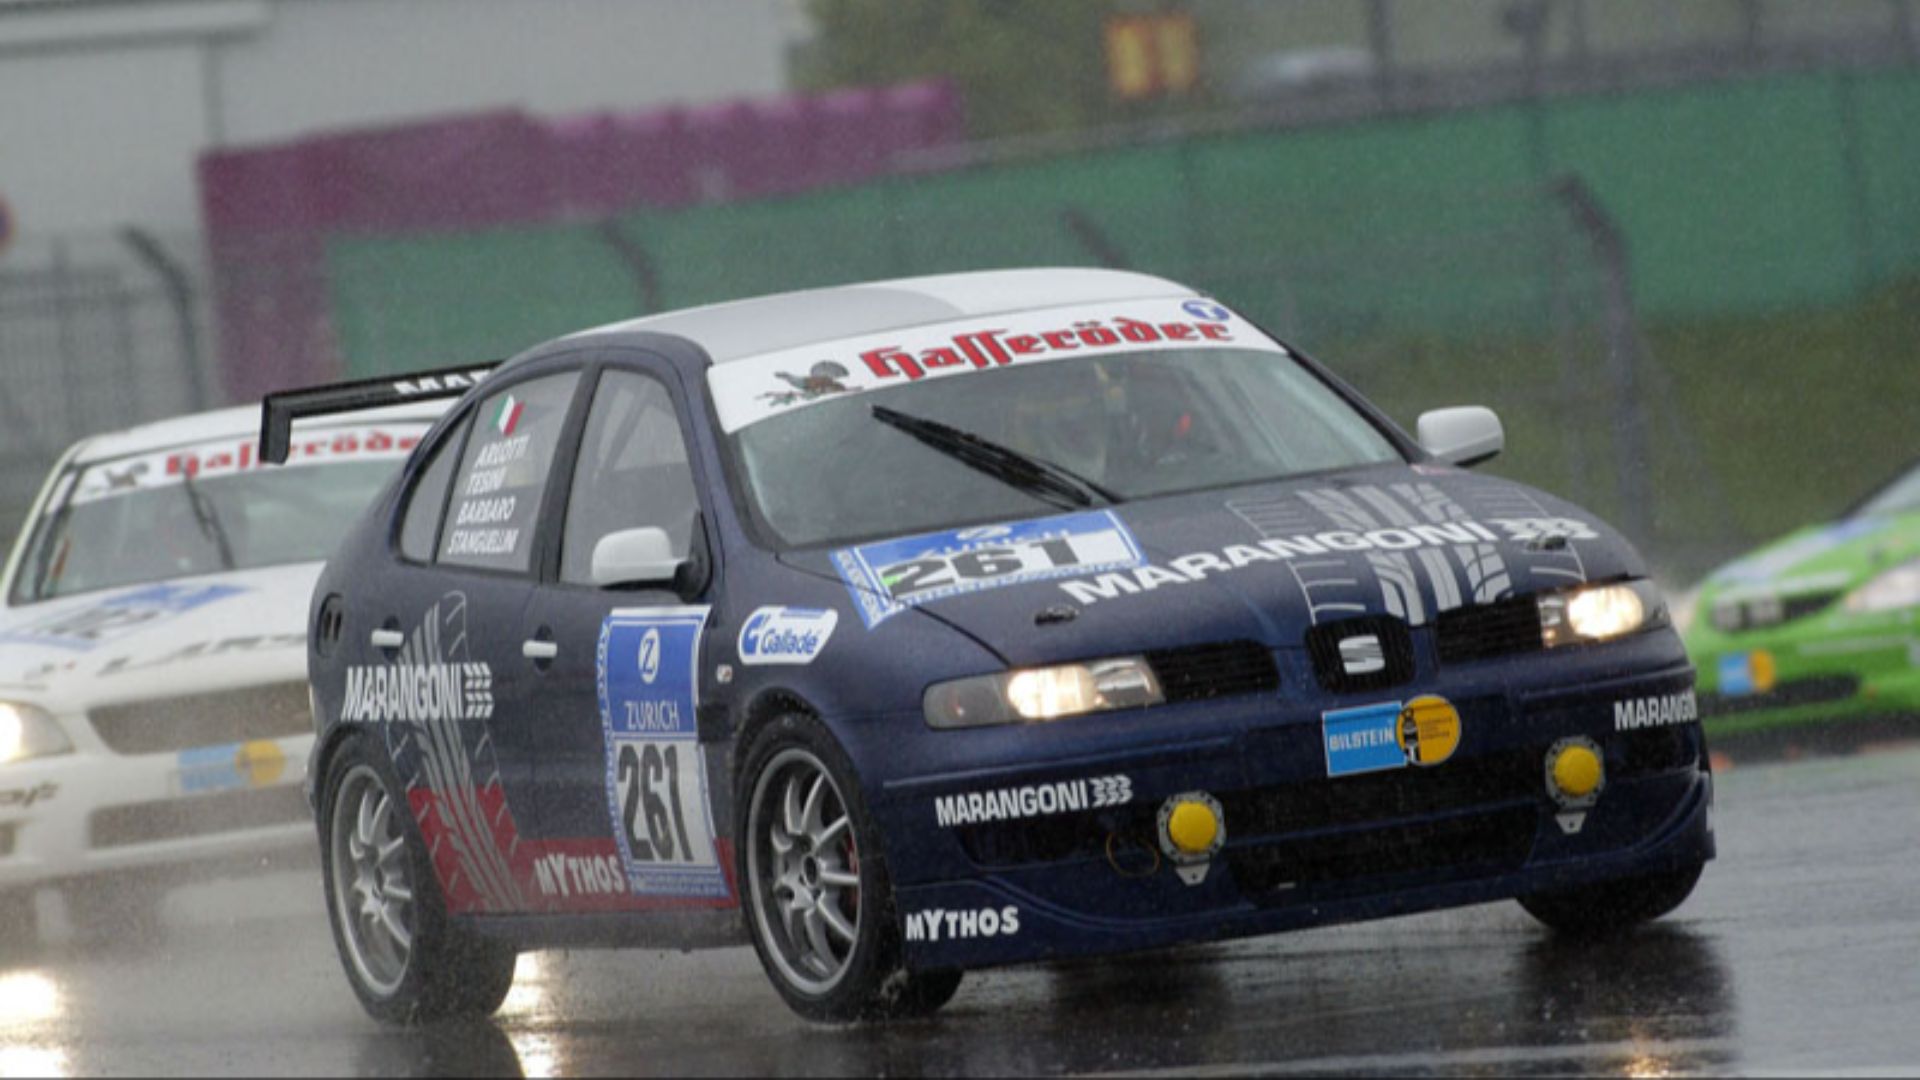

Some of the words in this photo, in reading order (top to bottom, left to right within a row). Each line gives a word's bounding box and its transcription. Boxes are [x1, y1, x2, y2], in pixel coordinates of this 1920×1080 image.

[456, 496, 516, 525] BARBARO
[881, 538, 1080, 600] 261
[1059, 520, 1498, 605] MARANGONI
[340, 662, 464, 721] MARANGONI
[624, 700, 680, 732] ZURICH
[1329, 726, 1395, 753] BILSTEIN
[618, 743, 694, 862] 261
[935, 779, 1088, 828] MARANGONI
[534, 853, 625, 897] MYTHOS
[905, 905, 1019, 942] MYTHOS
